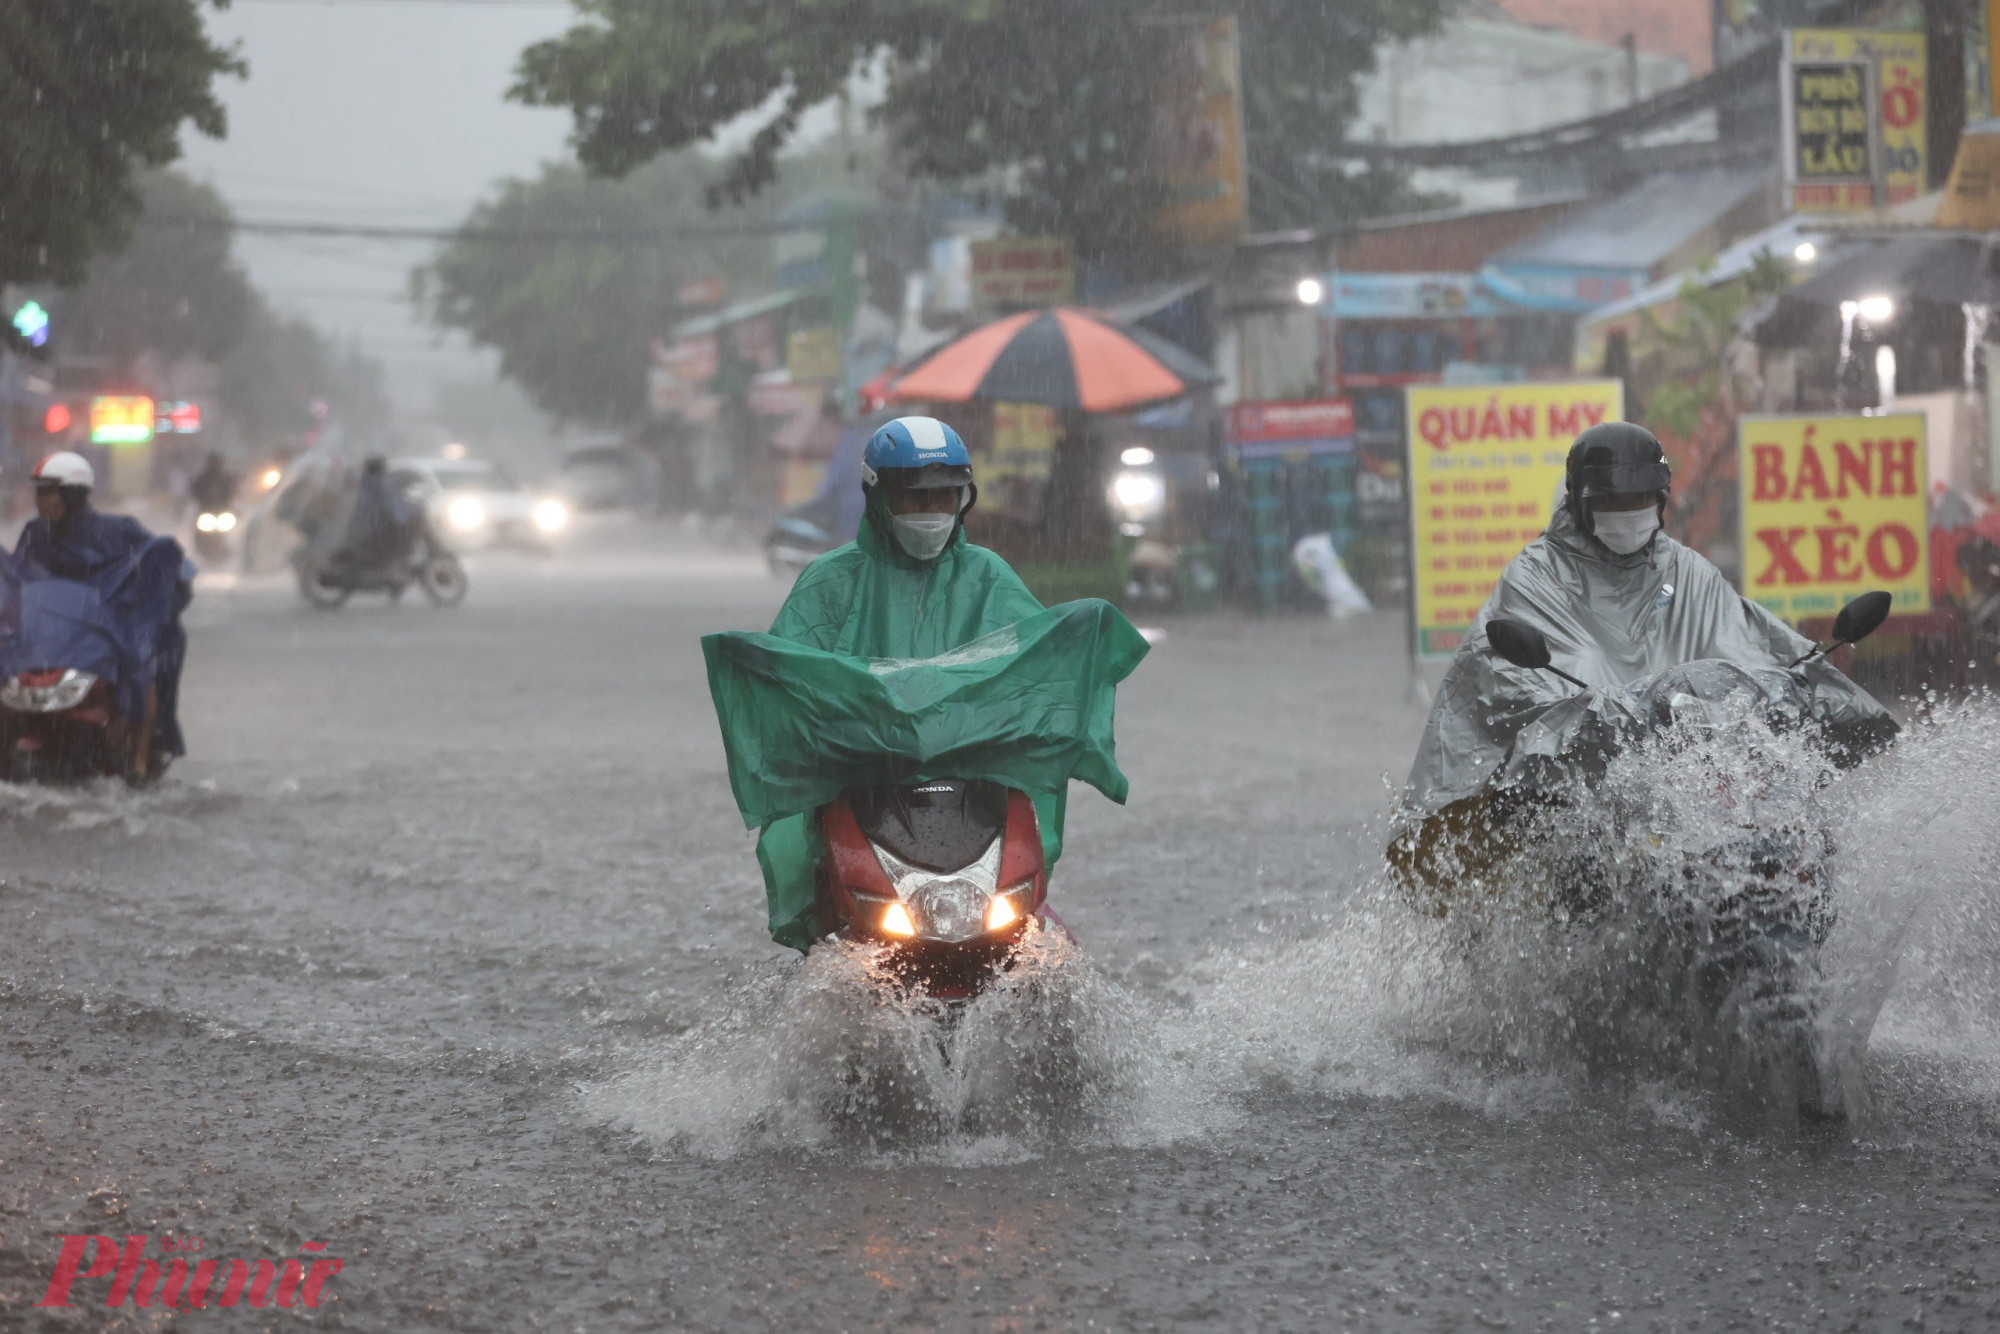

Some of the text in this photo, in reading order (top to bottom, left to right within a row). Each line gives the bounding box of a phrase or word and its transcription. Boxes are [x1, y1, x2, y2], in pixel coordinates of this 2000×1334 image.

[918, 451, 948, 459] HONDA
[1418, 393, 1535, 451] QUÁN
[1752, 424, 1917, 503] BÁNH
[1755, 507, 1920, 587] XÈO
